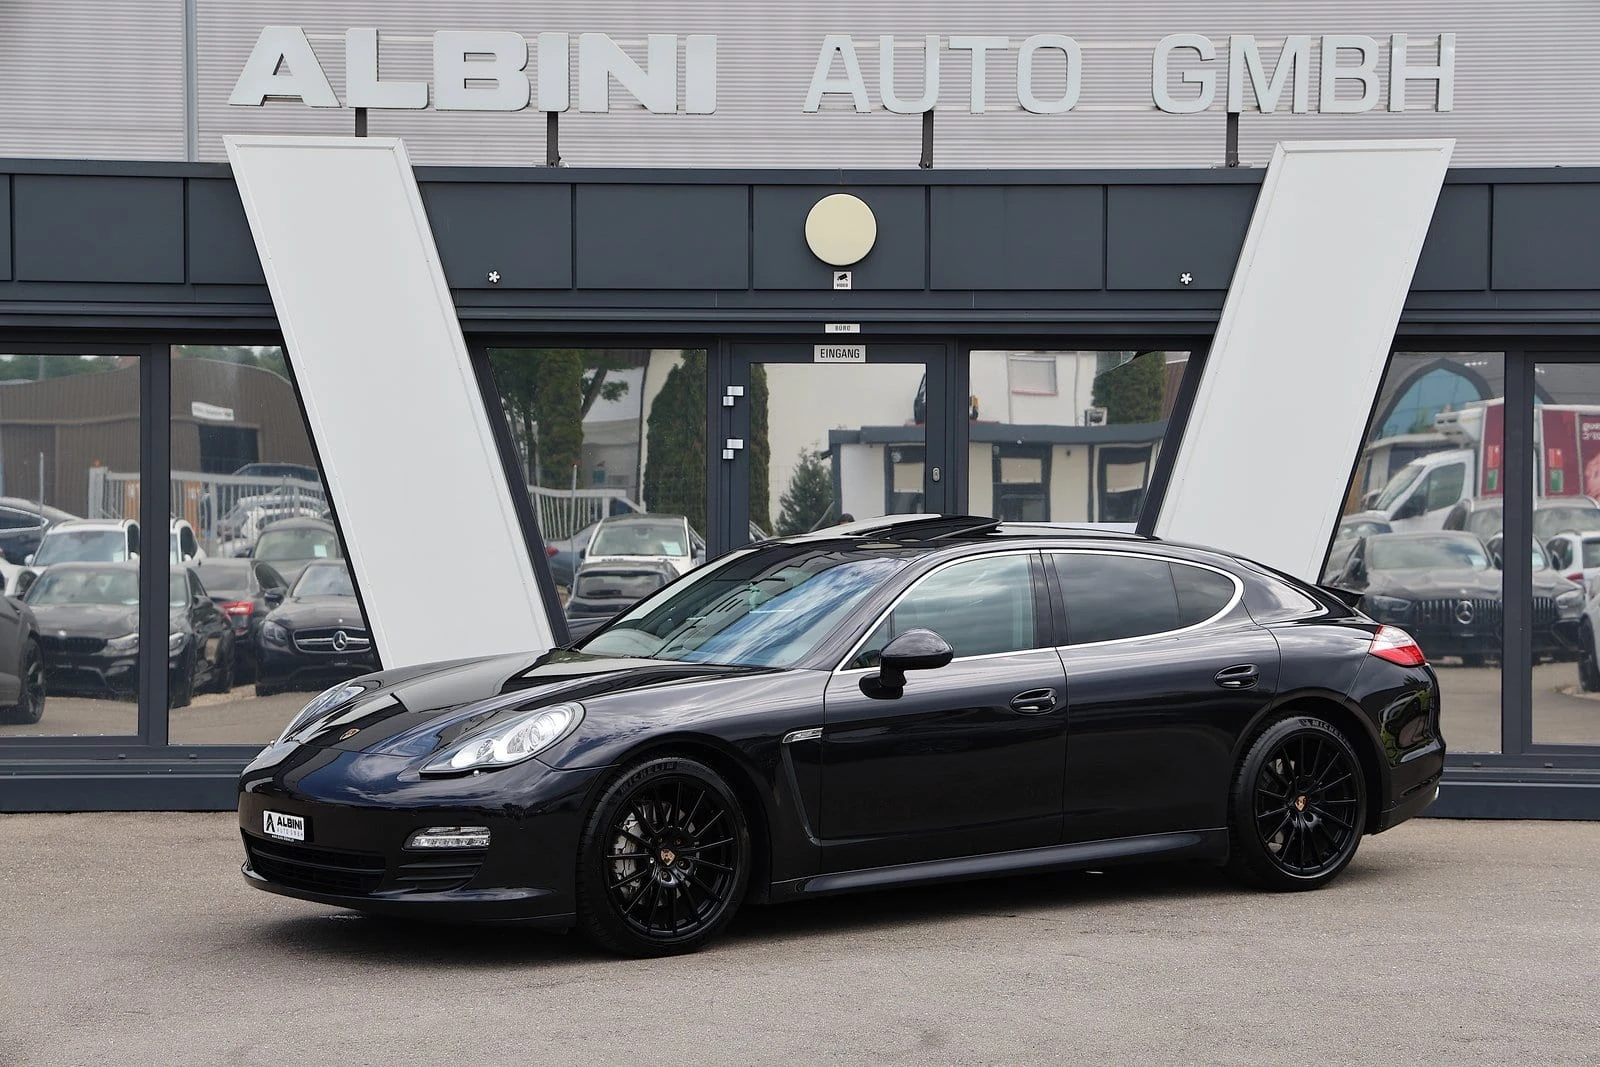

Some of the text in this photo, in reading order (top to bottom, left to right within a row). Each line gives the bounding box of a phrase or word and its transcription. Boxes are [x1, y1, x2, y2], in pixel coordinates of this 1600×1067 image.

[228, 25, 1456, 115] ALBINI AUTO GMBH
[820, 348, 860, 359] EINGANG
[277, 815, 303, 831] ALBINI
